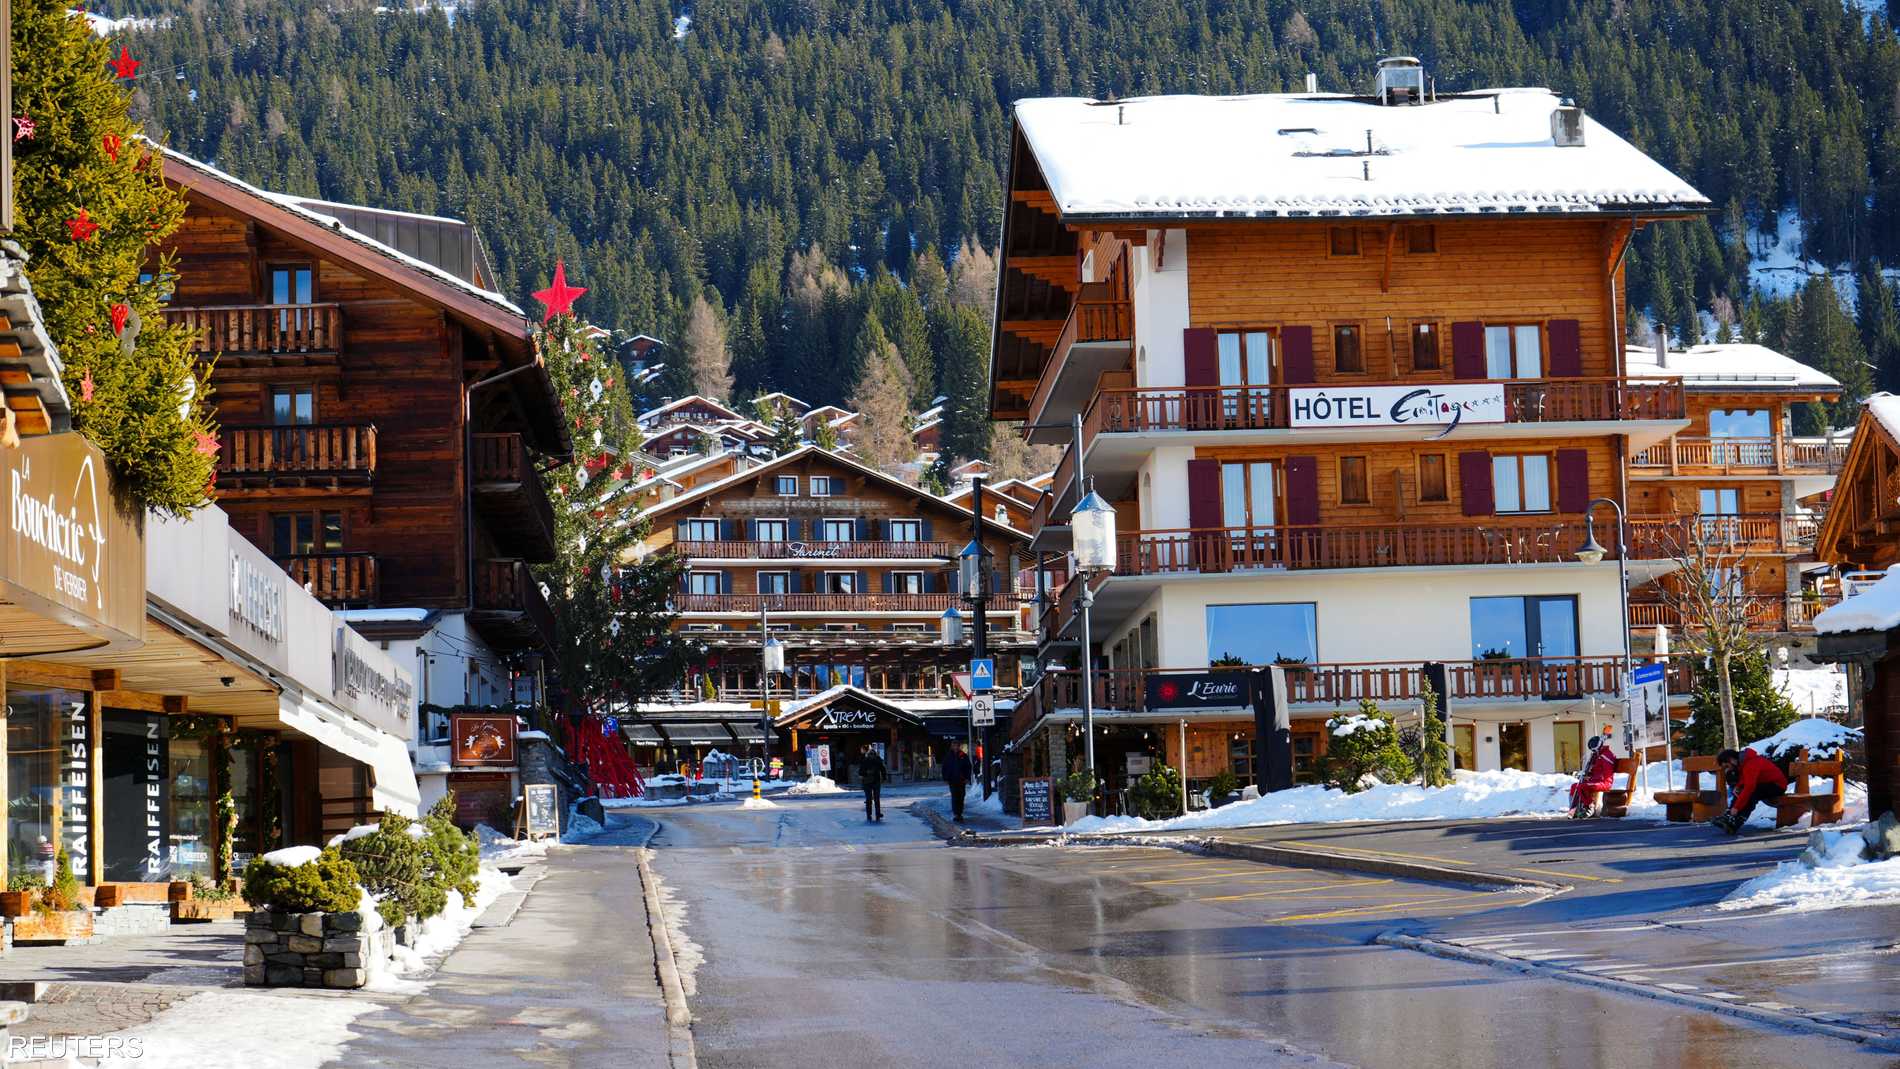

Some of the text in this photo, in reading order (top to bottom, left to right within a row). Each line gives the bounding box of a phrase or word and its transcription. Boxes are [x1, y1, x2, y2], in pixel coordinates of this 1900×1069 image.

[1294, 392, 1381, 420] HÔTEL
[21, 454, 30, 480] LA
[11, 468, 85, 566] Boucherie
[787, 541, 841, 558] Farinet
[53, 564, 63, 591] DE
[72, 702, 87, 876] RAIFFEISEN
[147, 722, 160, 874] RAIFFEISEN
